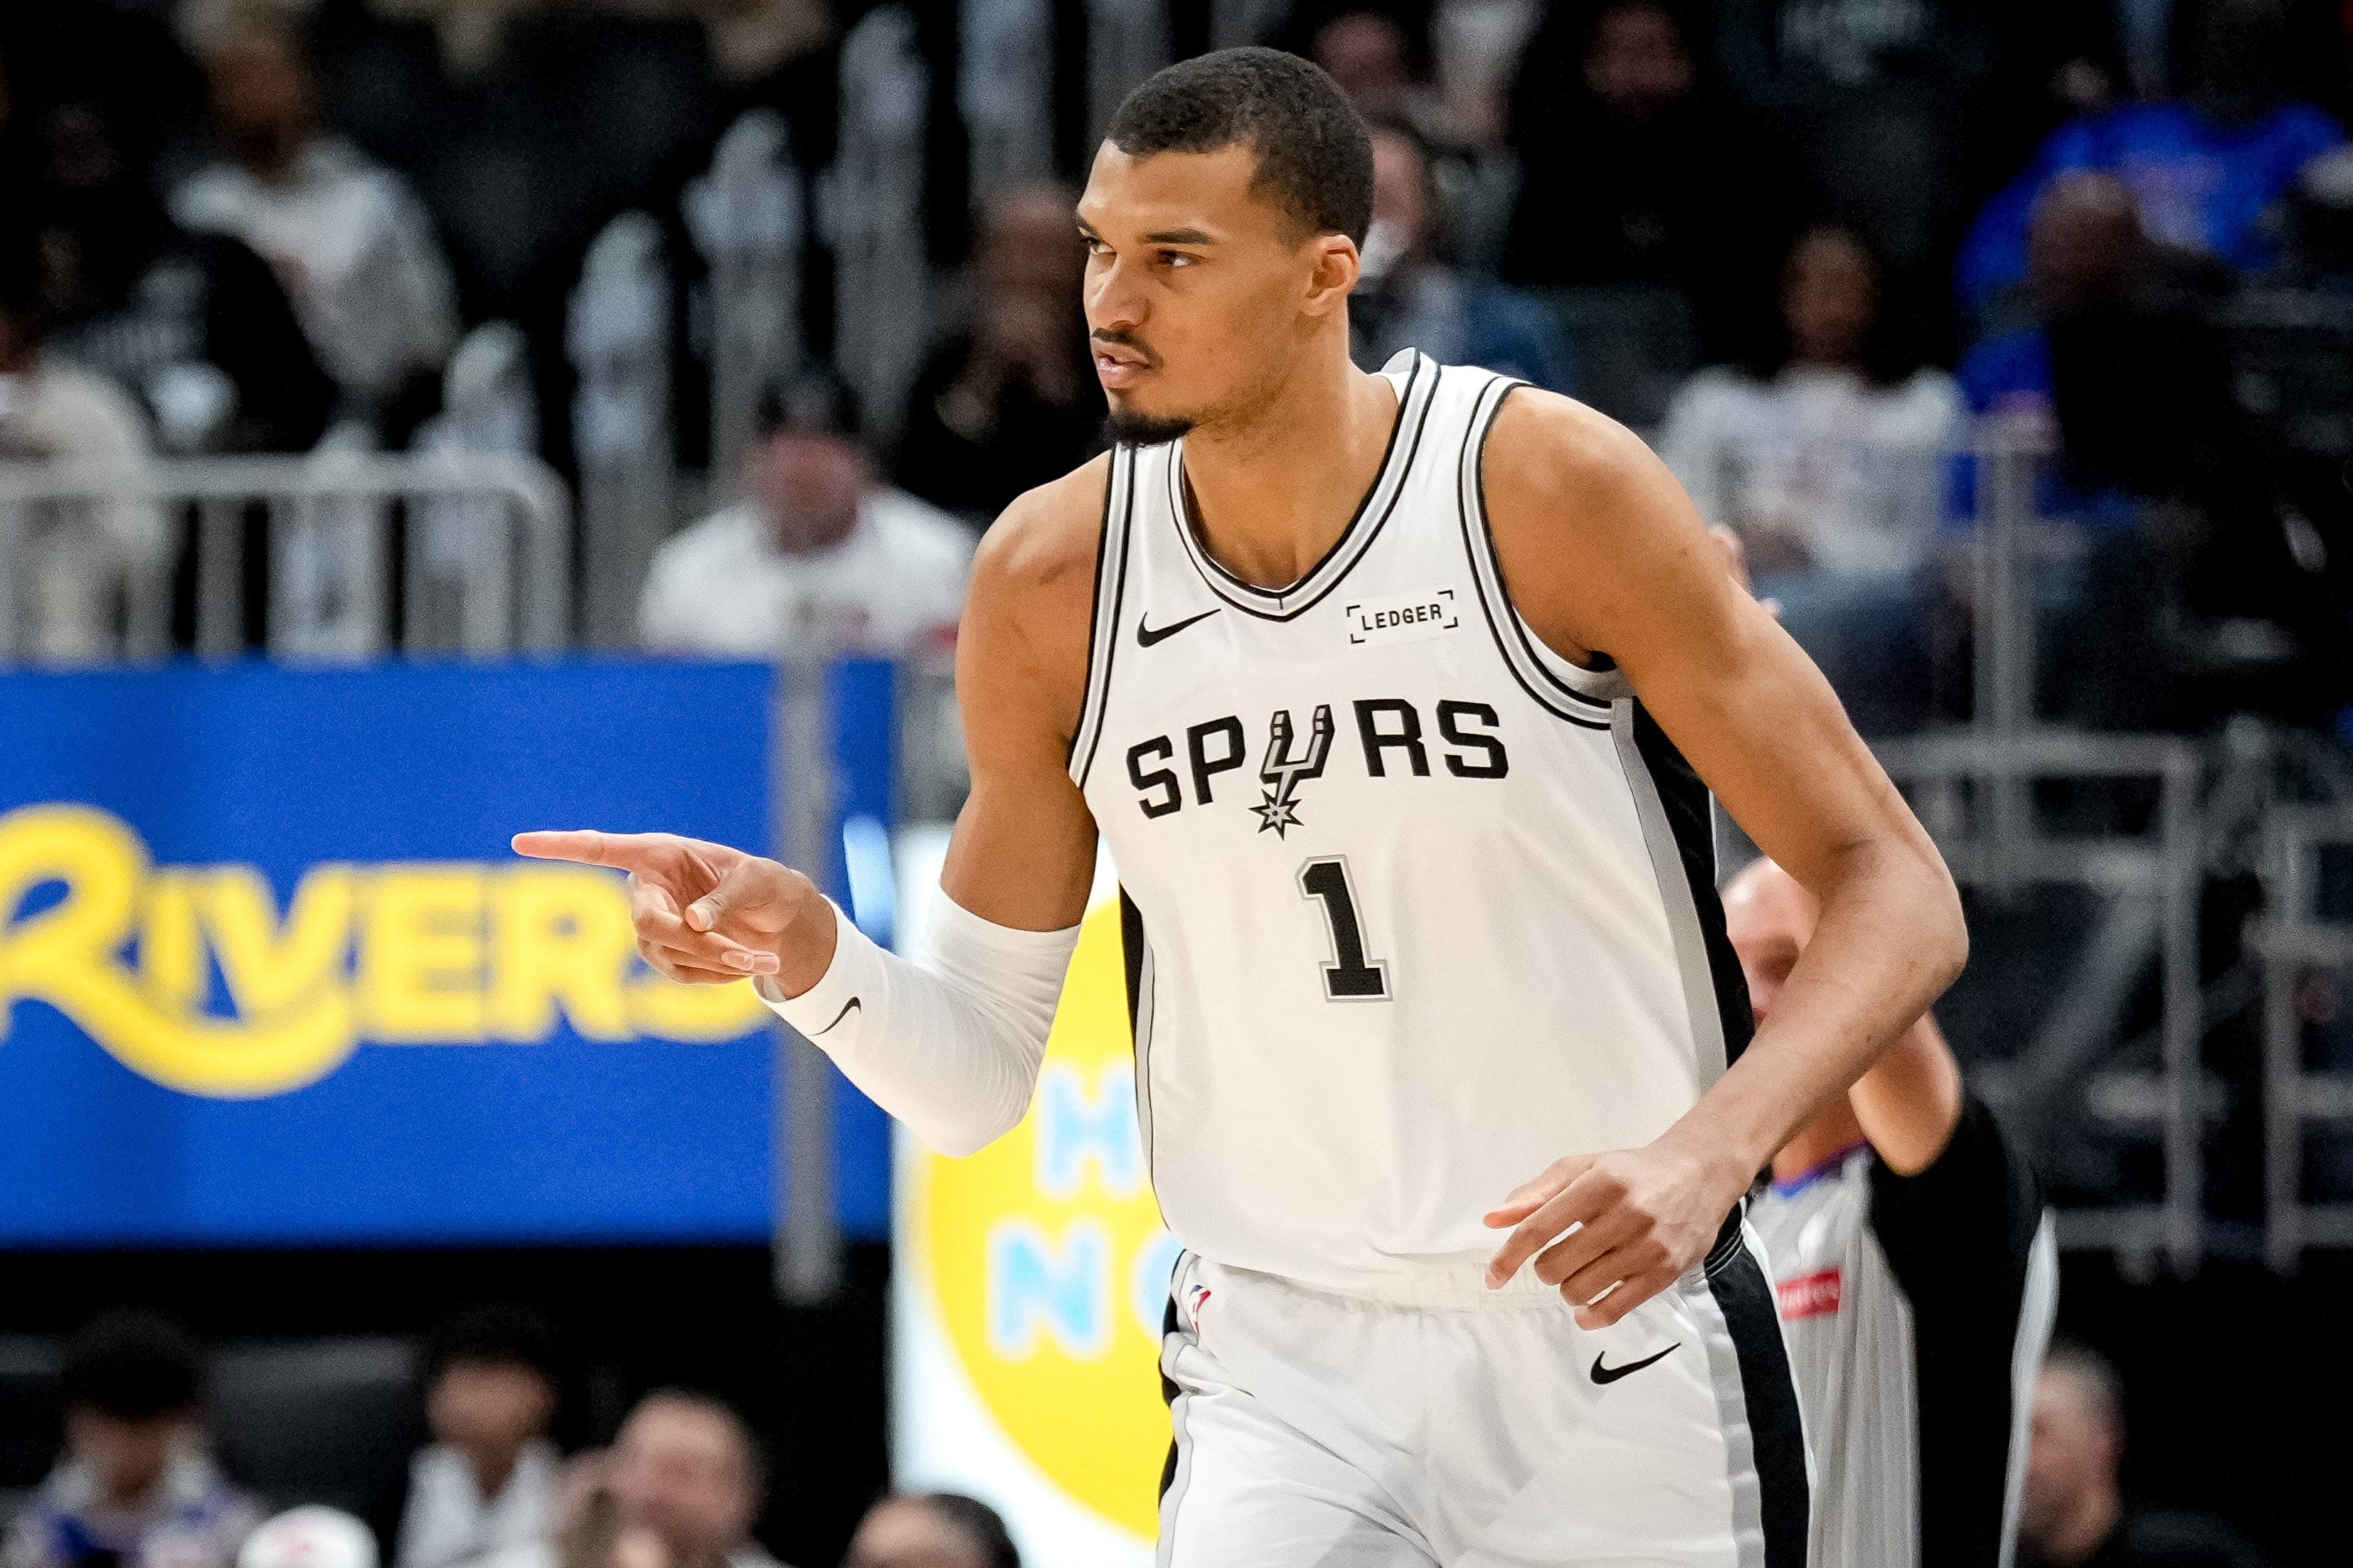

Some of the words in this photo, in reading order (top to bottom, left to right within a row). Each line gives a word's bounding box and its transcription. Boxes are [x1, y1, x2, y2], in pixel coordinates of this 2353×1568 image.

[1361, 604, 1443, 631] LEDGER
[1126, 698, 1509, 841] SPURS
[1295, 854, 1393, 1003] 1
